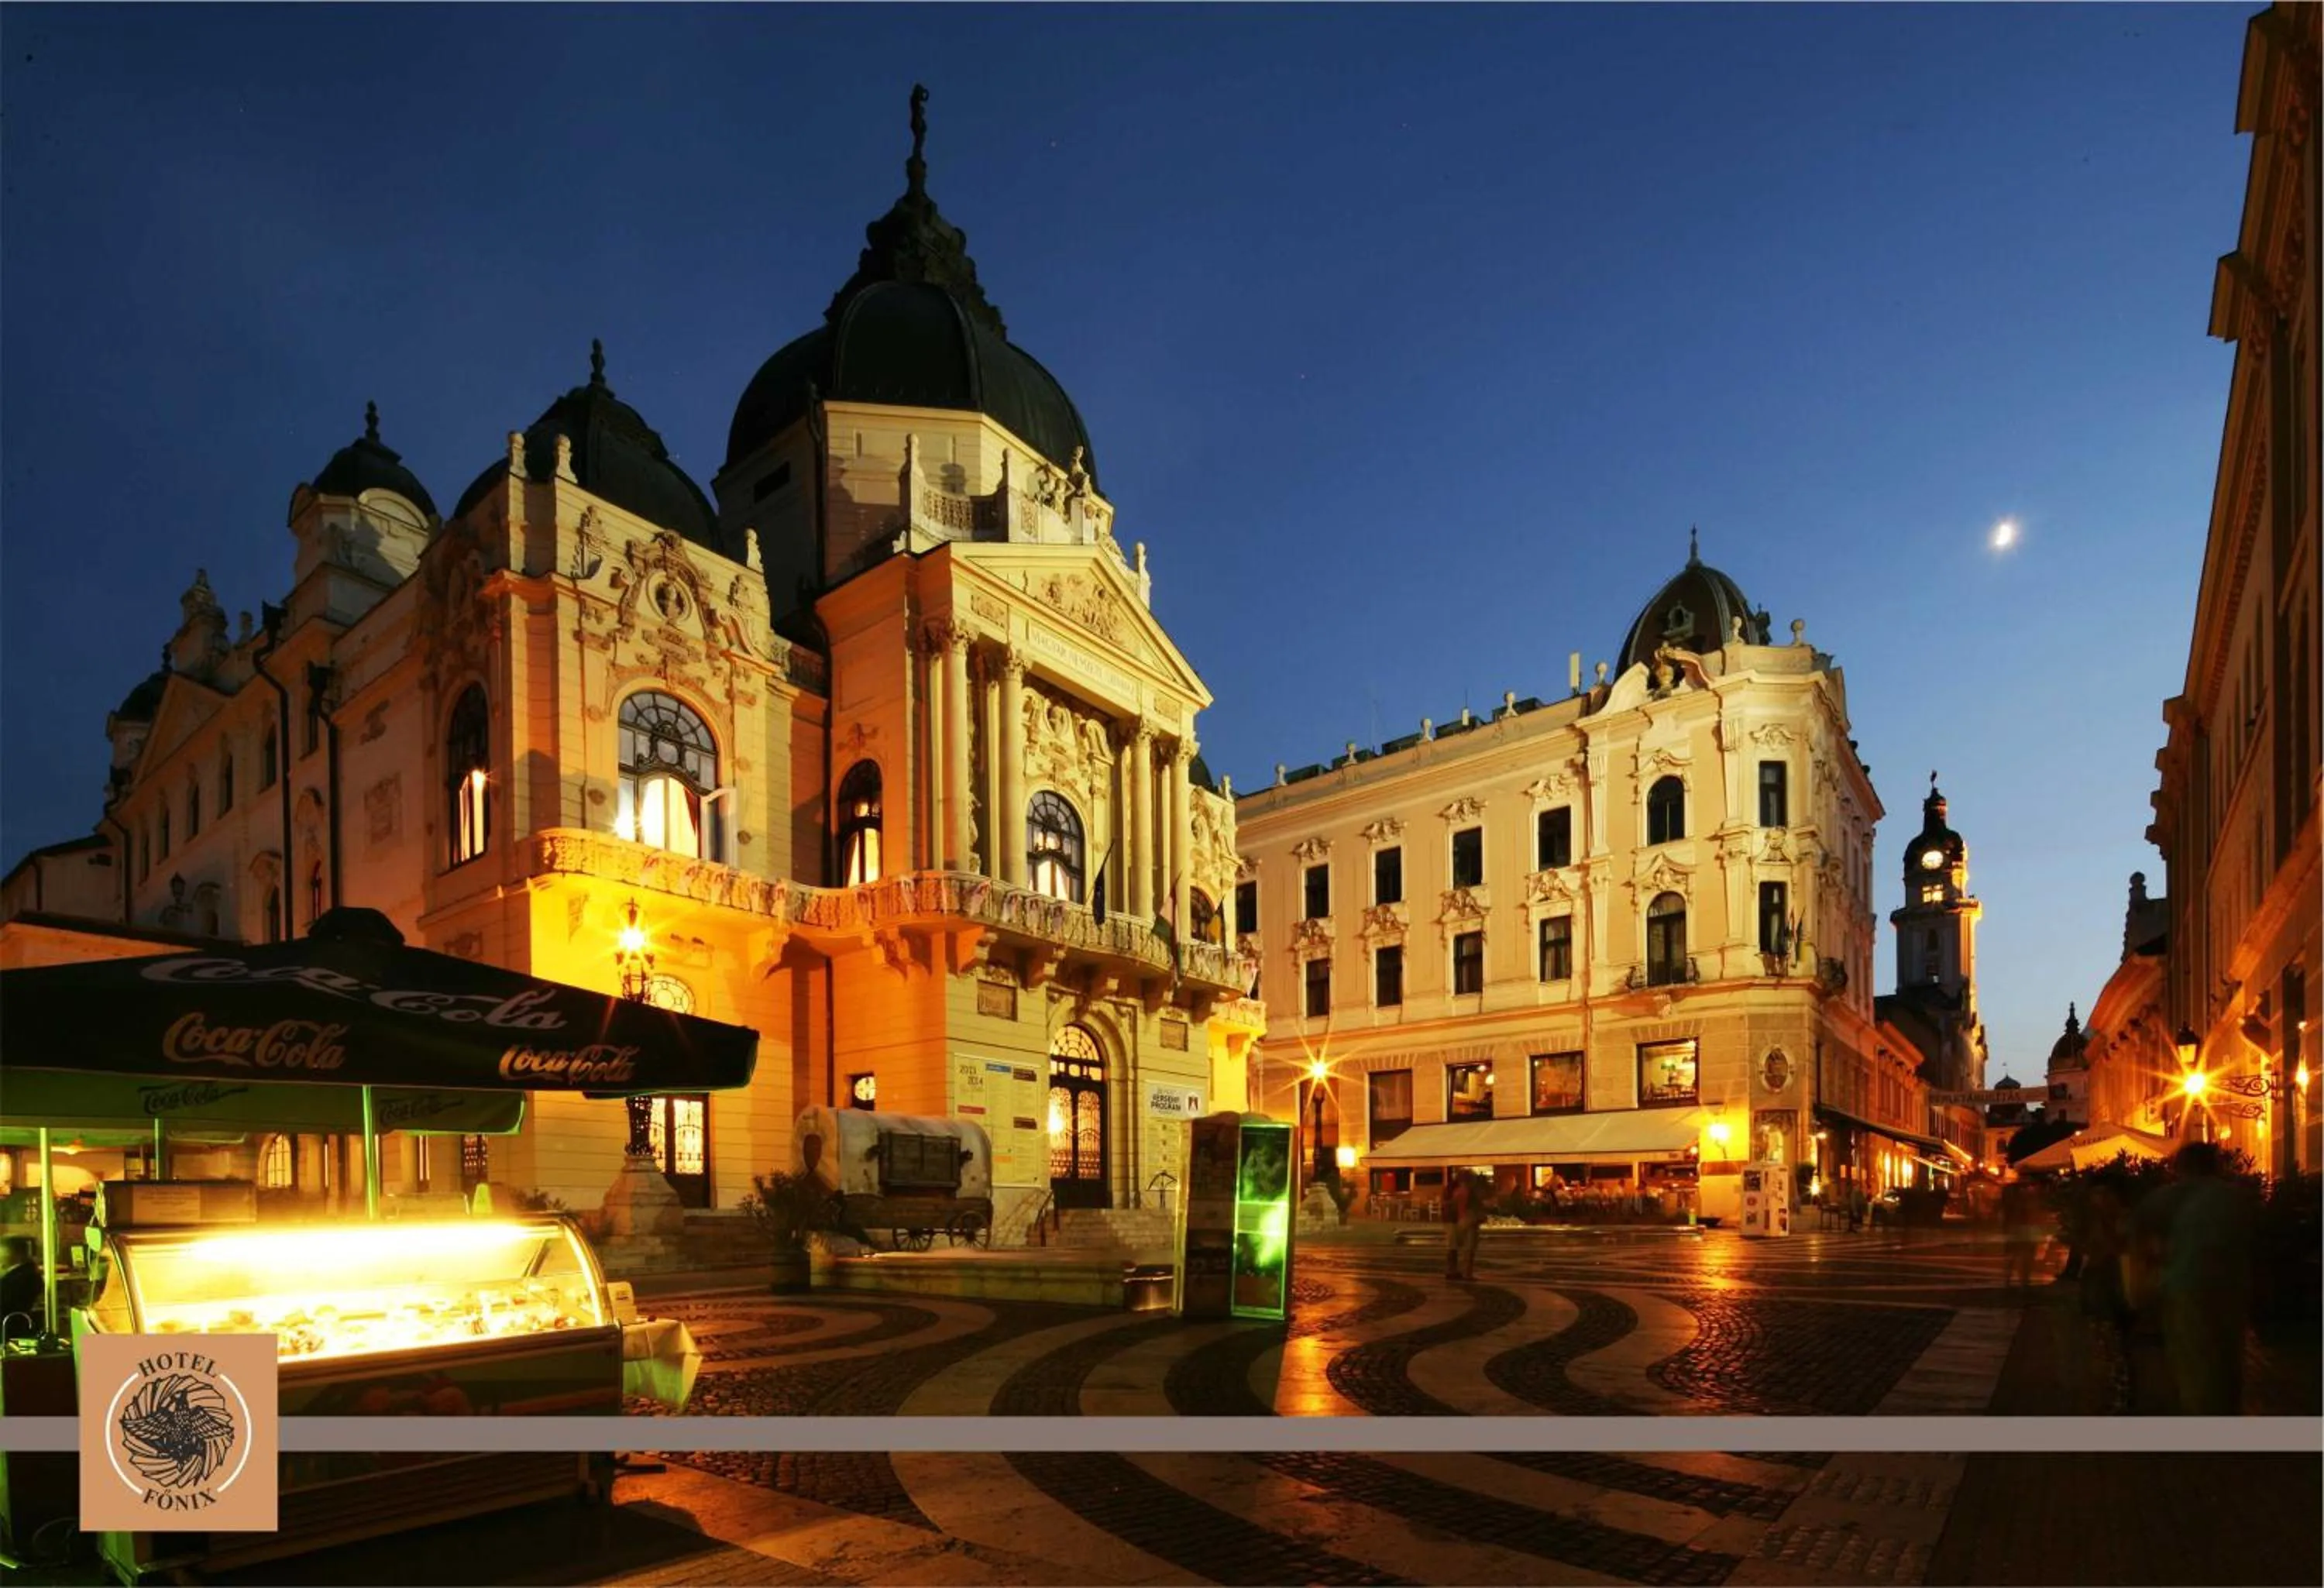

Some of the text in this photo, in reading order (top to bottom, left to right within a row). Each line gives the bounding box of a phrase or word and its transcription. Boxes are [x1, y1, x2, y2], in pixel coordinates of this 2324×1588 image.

[138, 957, 569, 1030] Coca-Cola
[162, 1011, 352, 1071] Coca-Cola
[497, 1043, 641, 1084] Coca-Cola
